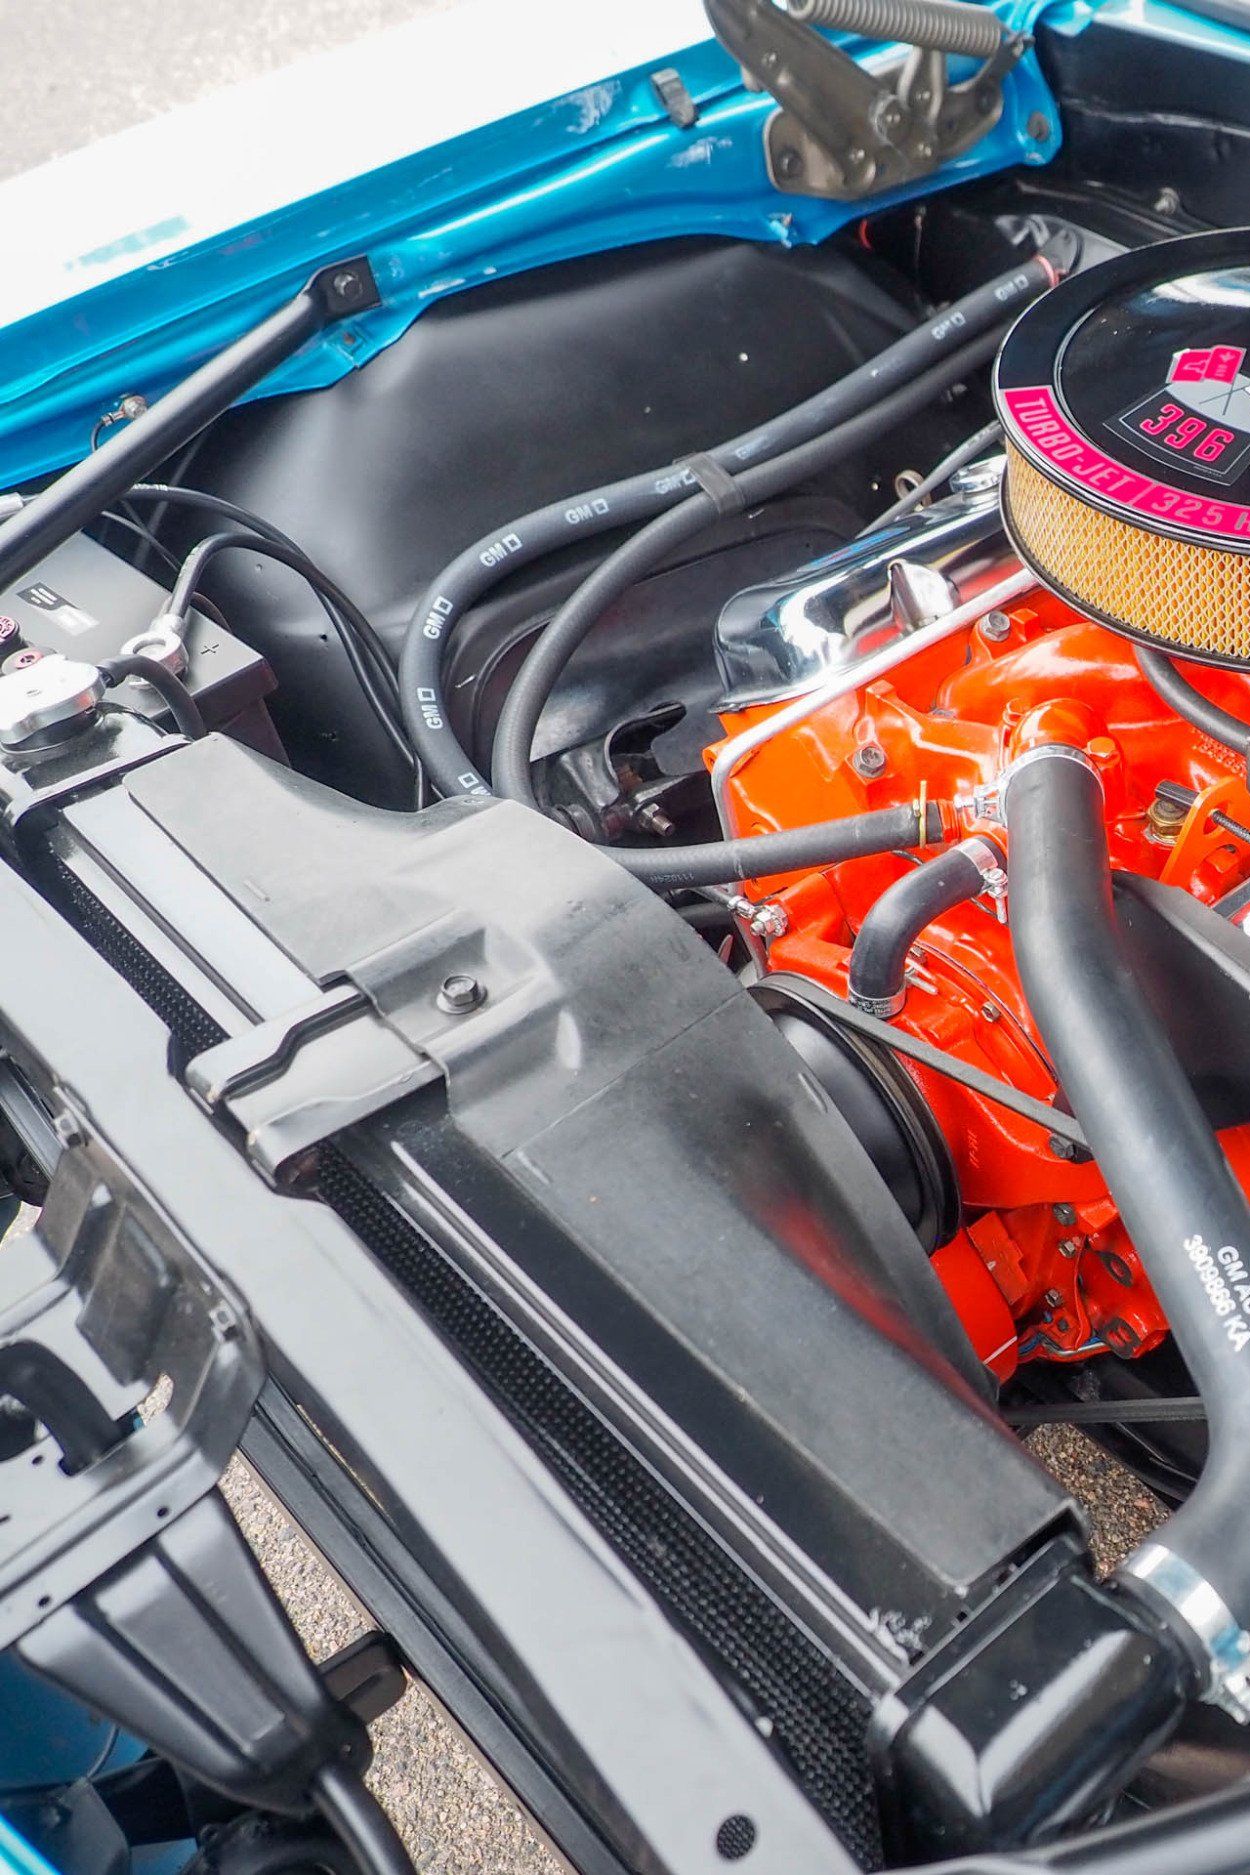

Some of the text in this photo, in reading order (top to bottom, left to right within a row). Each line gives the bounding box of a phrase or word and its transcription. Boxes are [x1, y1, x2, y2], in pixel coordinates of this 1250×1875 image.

[1014, 397, 1136, 493] TURBO-JET
[1139, 403, 1235, 462] 396
[564, 505, 593, 525] GM
[1151, 491, 1223, 527] 325
[478, 543, 509, 567] GM
[423, 612, 447, 640] GM
[420, 703, 444, 730] GM
[1217, 1245, 1248, 1282] GM
[1223, 1314, 1250, 1352] KA
